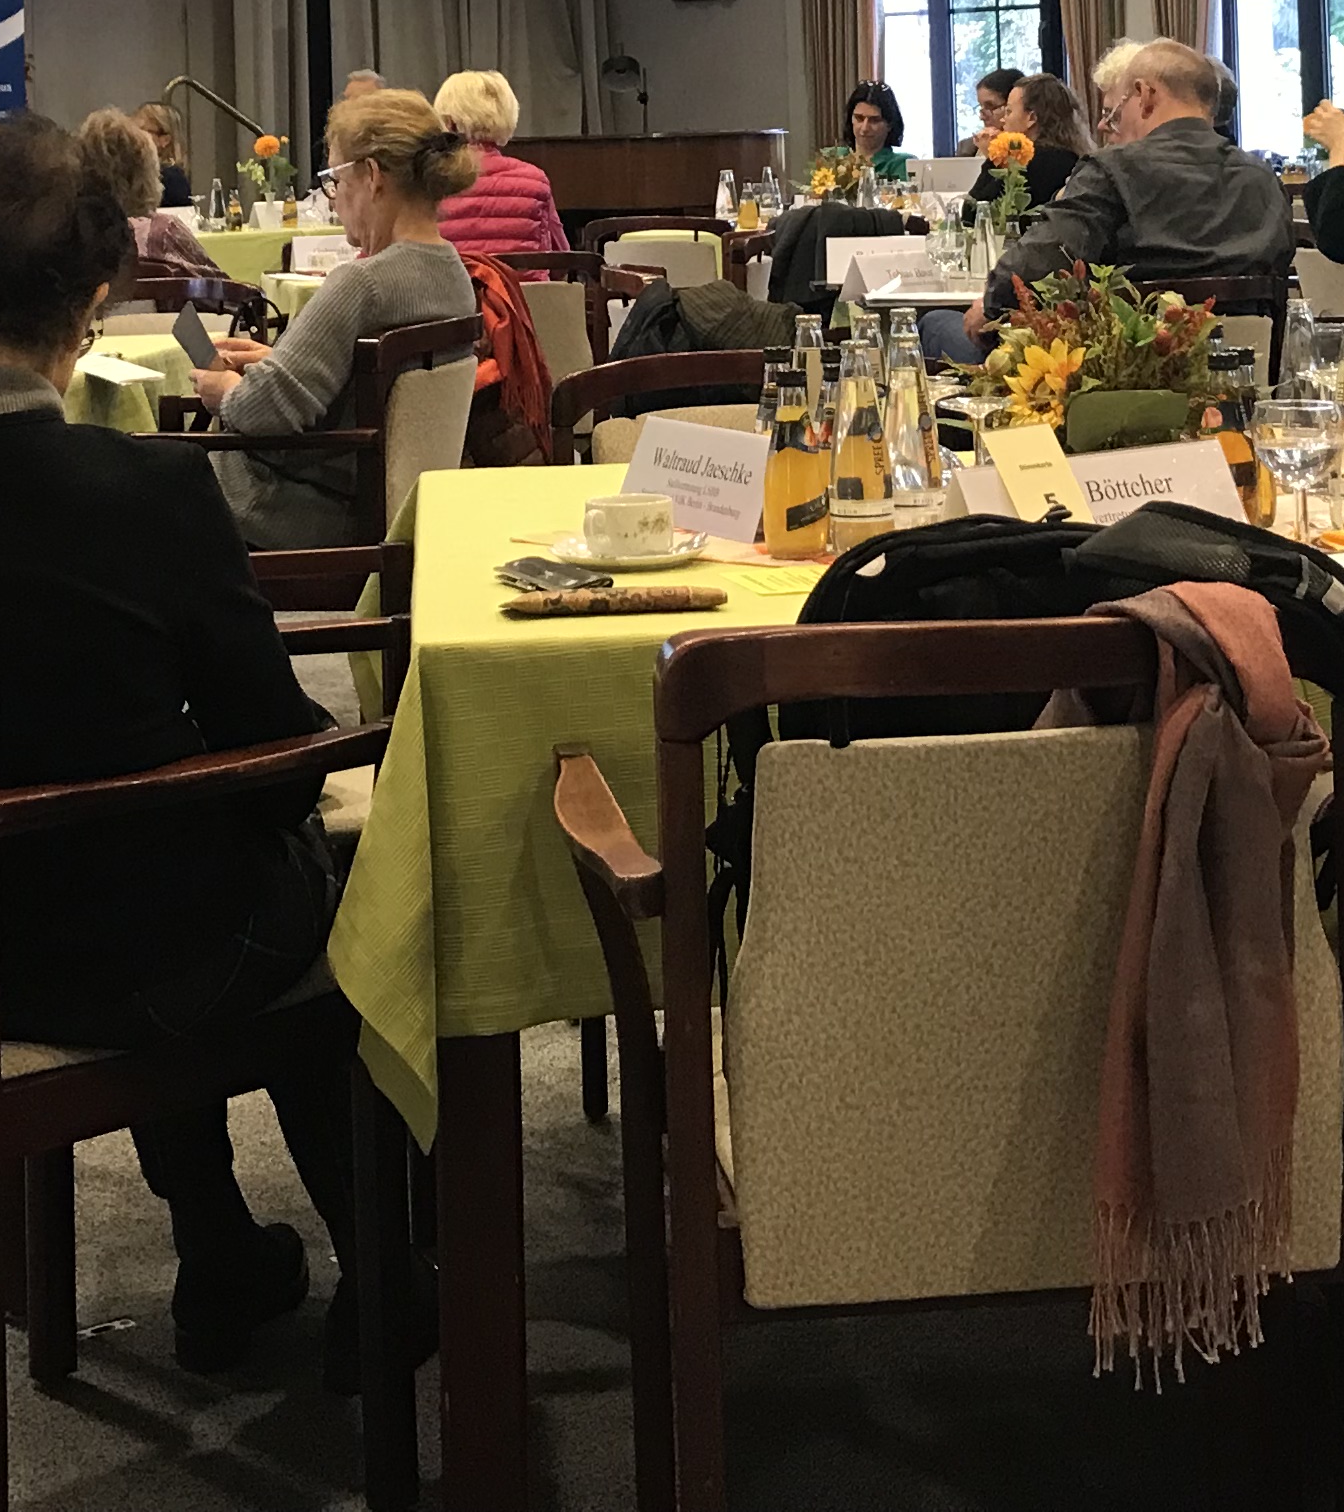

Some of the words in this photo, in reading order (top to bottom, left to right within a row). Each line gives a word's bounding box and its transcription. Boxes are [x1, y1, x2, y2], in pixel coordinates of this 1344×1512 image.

[653, 446, 704, 475] Waltraud
[700, 456, 753, 486] Jaeschke
[1085, 473, 1173, 503] Böttcher
